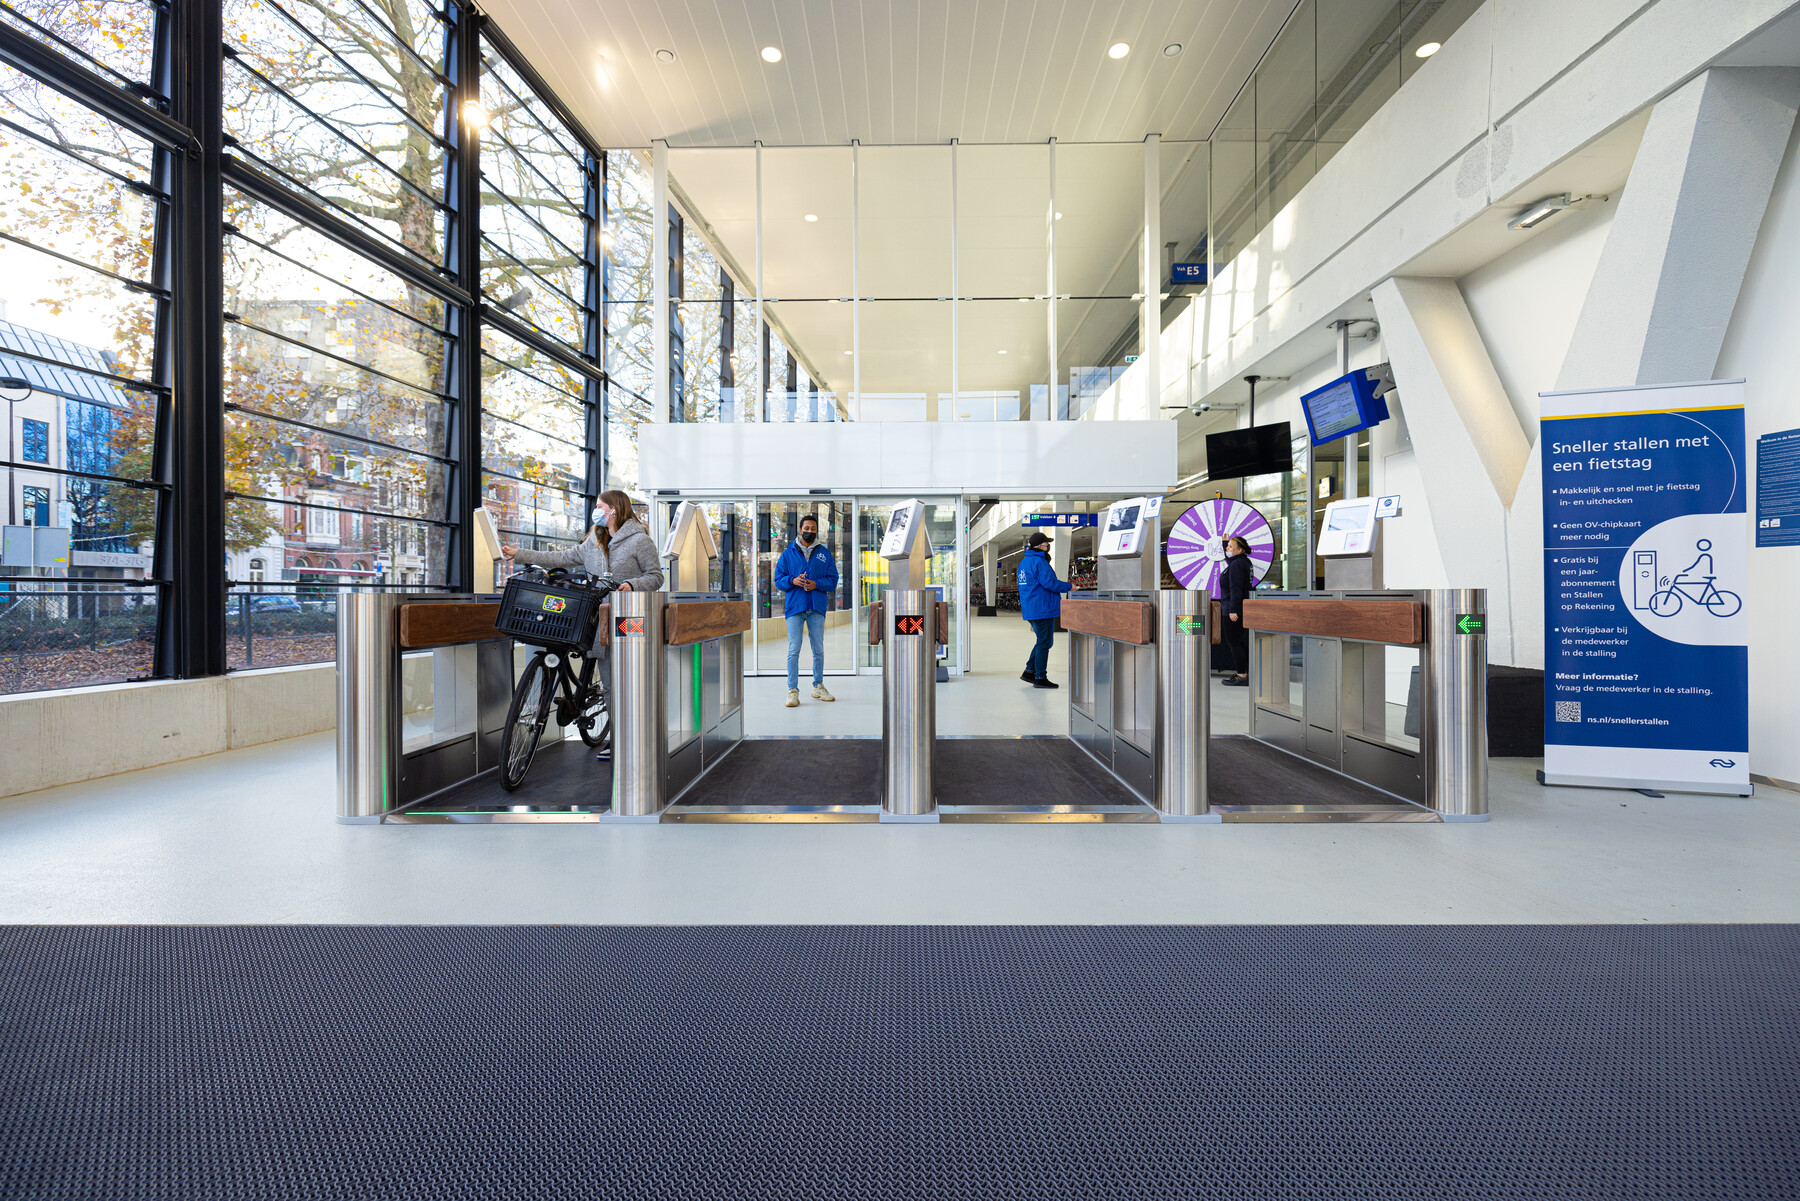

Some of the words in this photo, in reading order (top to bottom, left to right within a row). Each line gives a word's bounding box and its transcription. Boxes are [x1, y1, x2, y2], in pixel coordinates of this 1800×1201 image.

[1187, 266, 1199, 275] E5
[1553, 440, 1609, 454] Sneller
[1614, 437, 1670, 450] stallen
[1676, 435, 1710, 447] met
[1553, 462, 1583, 471] een
[1588, 457, 1652, 470] fietstag
[1559, 486, 1601, 495] Makkelijk
[1616, 484, 1634, 493] snel
[1636, 484, 1654, 492] met
[1655, 483, 1665, 493] je
[1666, 482, 1701, 491] fietstag
[1586, 497, 1633, 505] uitchecken
[1584, 520, 1642, 529] OV-chipkaart
[1584, 532, 1610, 542] nodig
[99, 554, 145, 566] 374-376
[1560, 556, 1586, 564] Gratis
[1587, 556, 1599, 565] bij
[1578, 568, 1599, 577] jaar-
[1560, 579, 1616, 587] abonnement
[1573, 591, 1603, 599] Stallen
[1560, 604, 1573, 612] op
[1574, 602, 1615, 612] Rekening
[1561, 626, 1615, 635] Verkrijgbaar
[1616, 626, 1628, 635] bij
[1561, 637, 1573, 645] de
[1574, 637, 1629, 646] medewerker
[1561, 649, 1571, 657] in
[1572, 649, 1584, 657] de
[1585, 649, 1617, 659] stalling
[1555, 672, 1581, 680] Meer
[1582, 672, 1639, 681] informatie?
[1555, 684, 1581, 693] Vraag
[1582, 684, 1594, 692] de
[1595, 685, 1651, 693] medewerker
[1652, 686, 1662, 694] in
[1663, 686, 1675, 694] de
[1676, 686, 1713, 697] stalling.
[1587, 716, 1670, 726] ns.nl/snellerstallen
